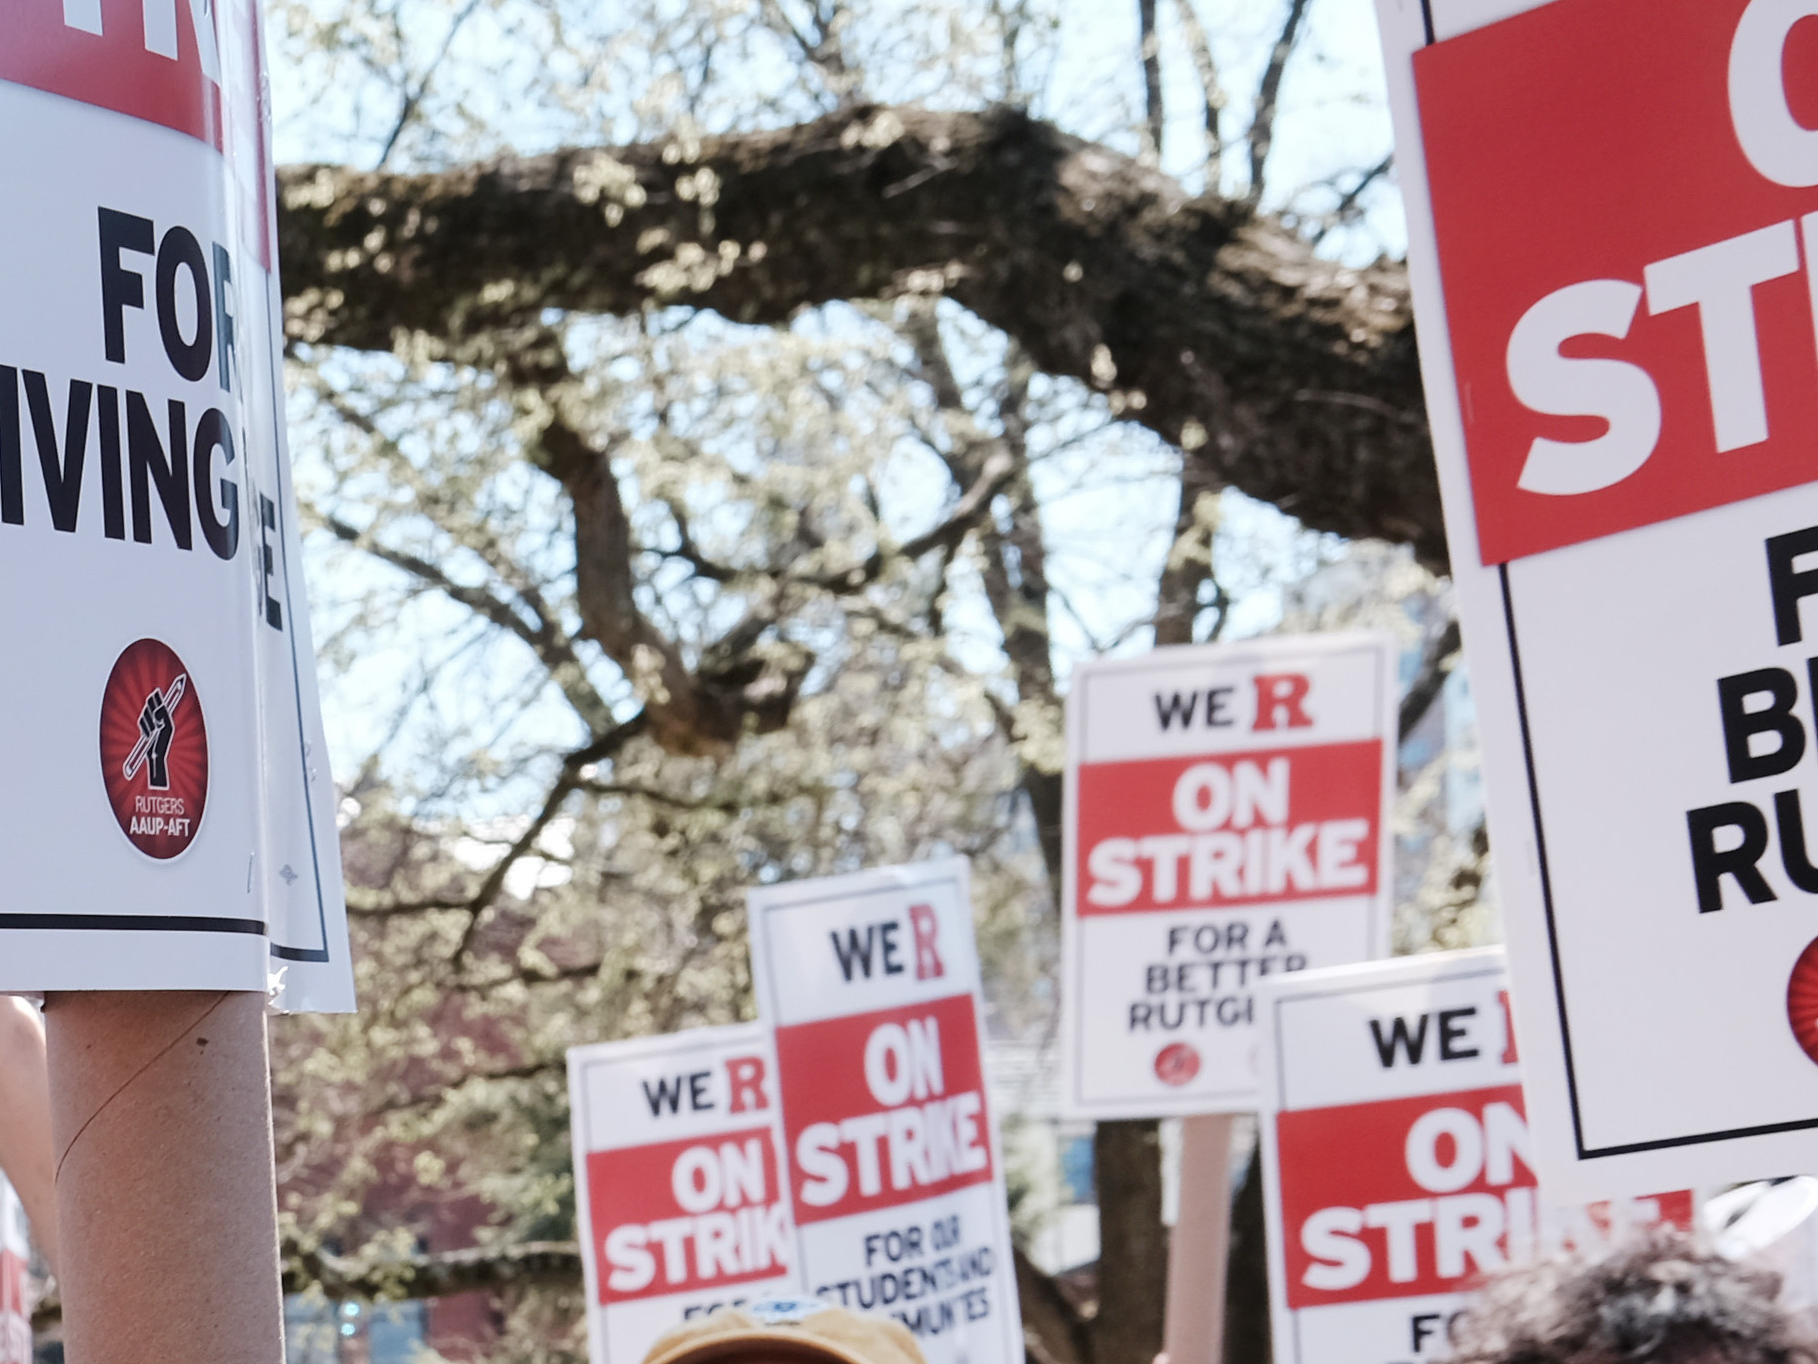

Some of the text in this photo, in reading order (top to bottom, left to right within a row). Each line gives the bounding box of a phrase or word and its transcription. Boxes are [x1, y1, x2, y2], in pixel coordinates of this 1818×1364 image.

[1505, 211, 1818, 495] ST
[1154, 672, 1314, 733] WE R
[130, 816, 190, 837] AAUP-AFT
[135, 795, 185, 815] RUTGERS
[1172, 756, 1290, 831] ON
[1087, 818, 1369, 909] STRIKE
[831, 904, 945, 981] WE R
[1168, 918, 1288, 956] FOR A
[864, 1016, 944, 1106] ON
[1369, 1006, 1479, 1068] WE
[643, 1056, 769, 1118] WE R
[673, 1138, 767, 1213] ON
[796, 1091, 988, 1208] STRIKE
[605, 1203, 787, 1292] STRIK
[865, 1225, 923, 1266] FOR
